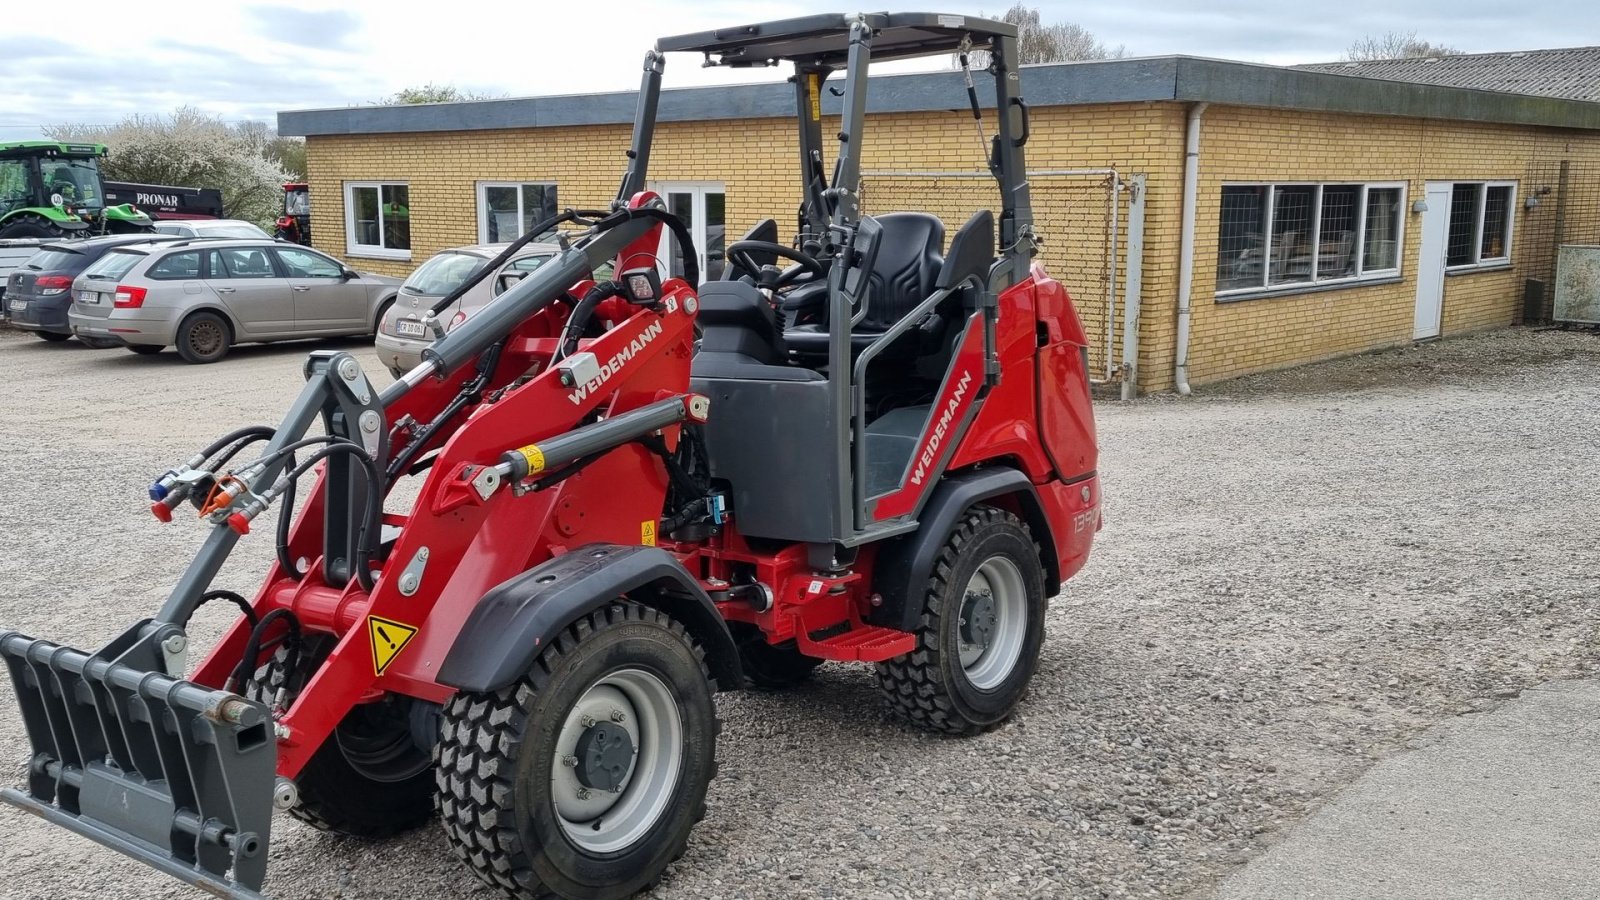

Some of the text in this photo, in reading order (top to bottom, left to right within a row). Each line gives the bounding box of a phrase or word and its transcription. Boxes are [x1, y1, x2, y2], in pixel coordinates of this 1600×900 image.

[136, 192, 178, 207] PRONAR
[567, 319, 663, 406] WEIDEMANN
[910, 370, 972, 486] WEIDEMANN
[1073, 508, 1098, 535] 1390
